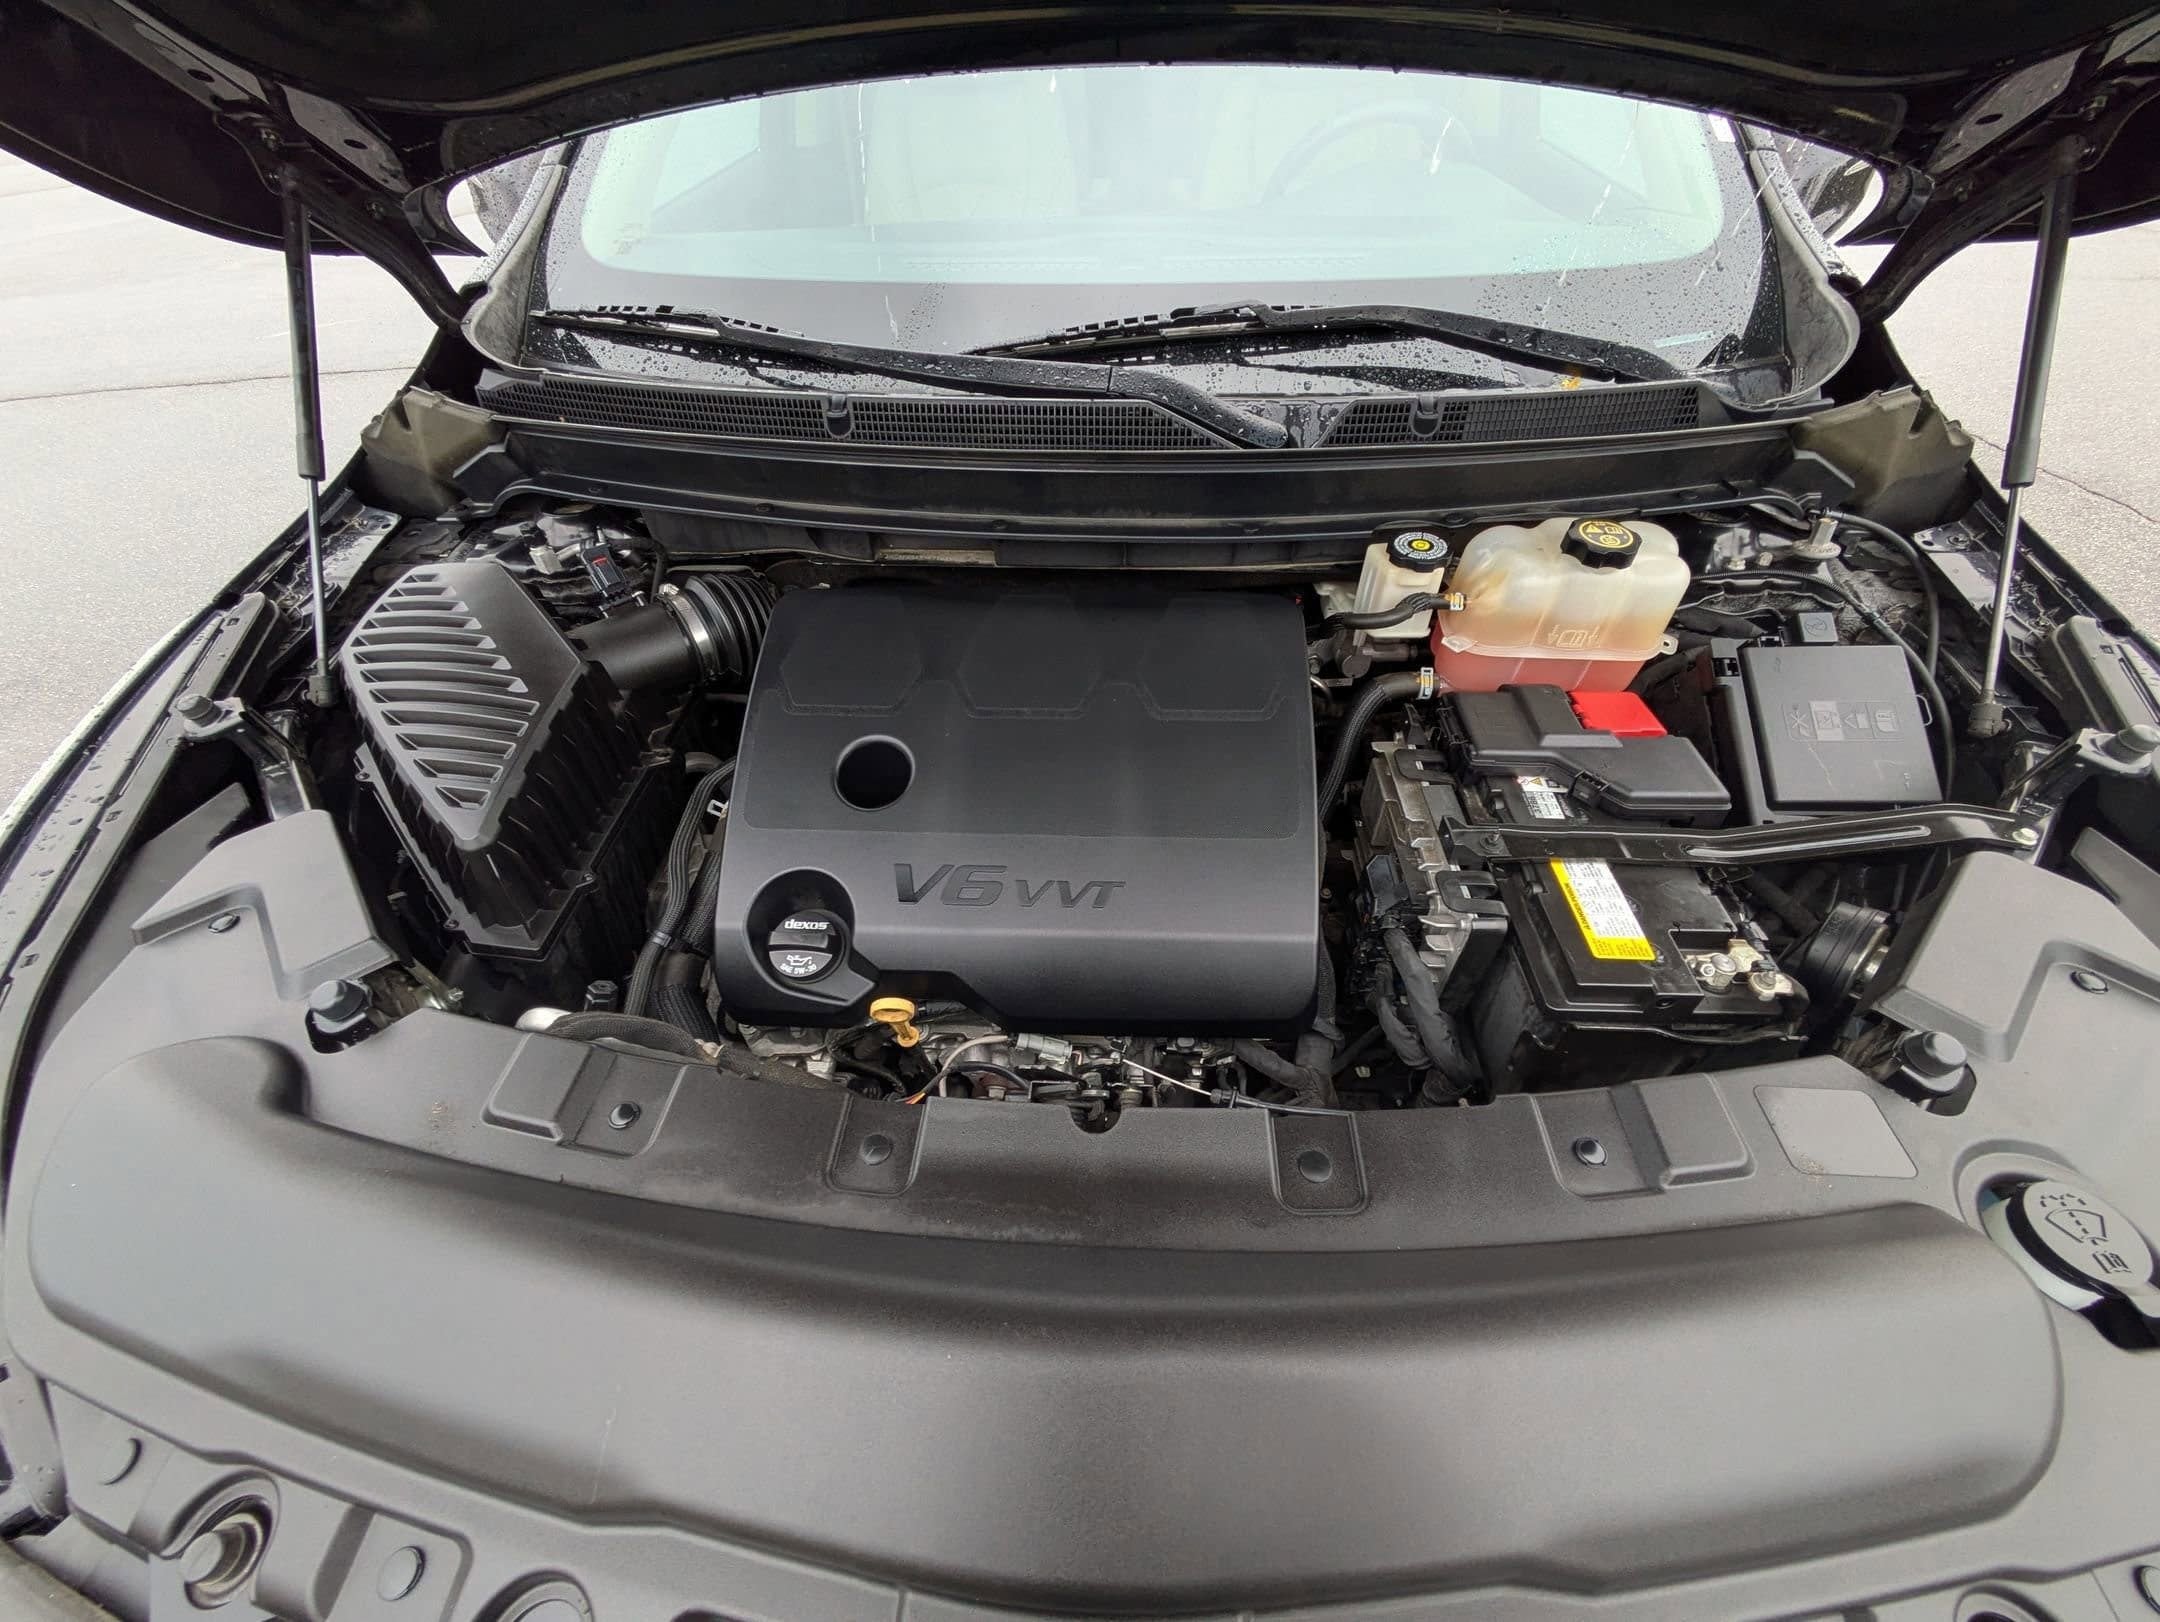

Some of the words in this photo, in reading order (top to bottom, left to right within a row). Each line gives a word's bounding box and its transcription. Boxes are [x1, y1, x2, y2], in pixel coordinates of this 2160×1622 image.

[894, 863, 1007, 905] V6
[1015, 879, 1126, 908] VVT
[784, 918, 830, 930] dexos
